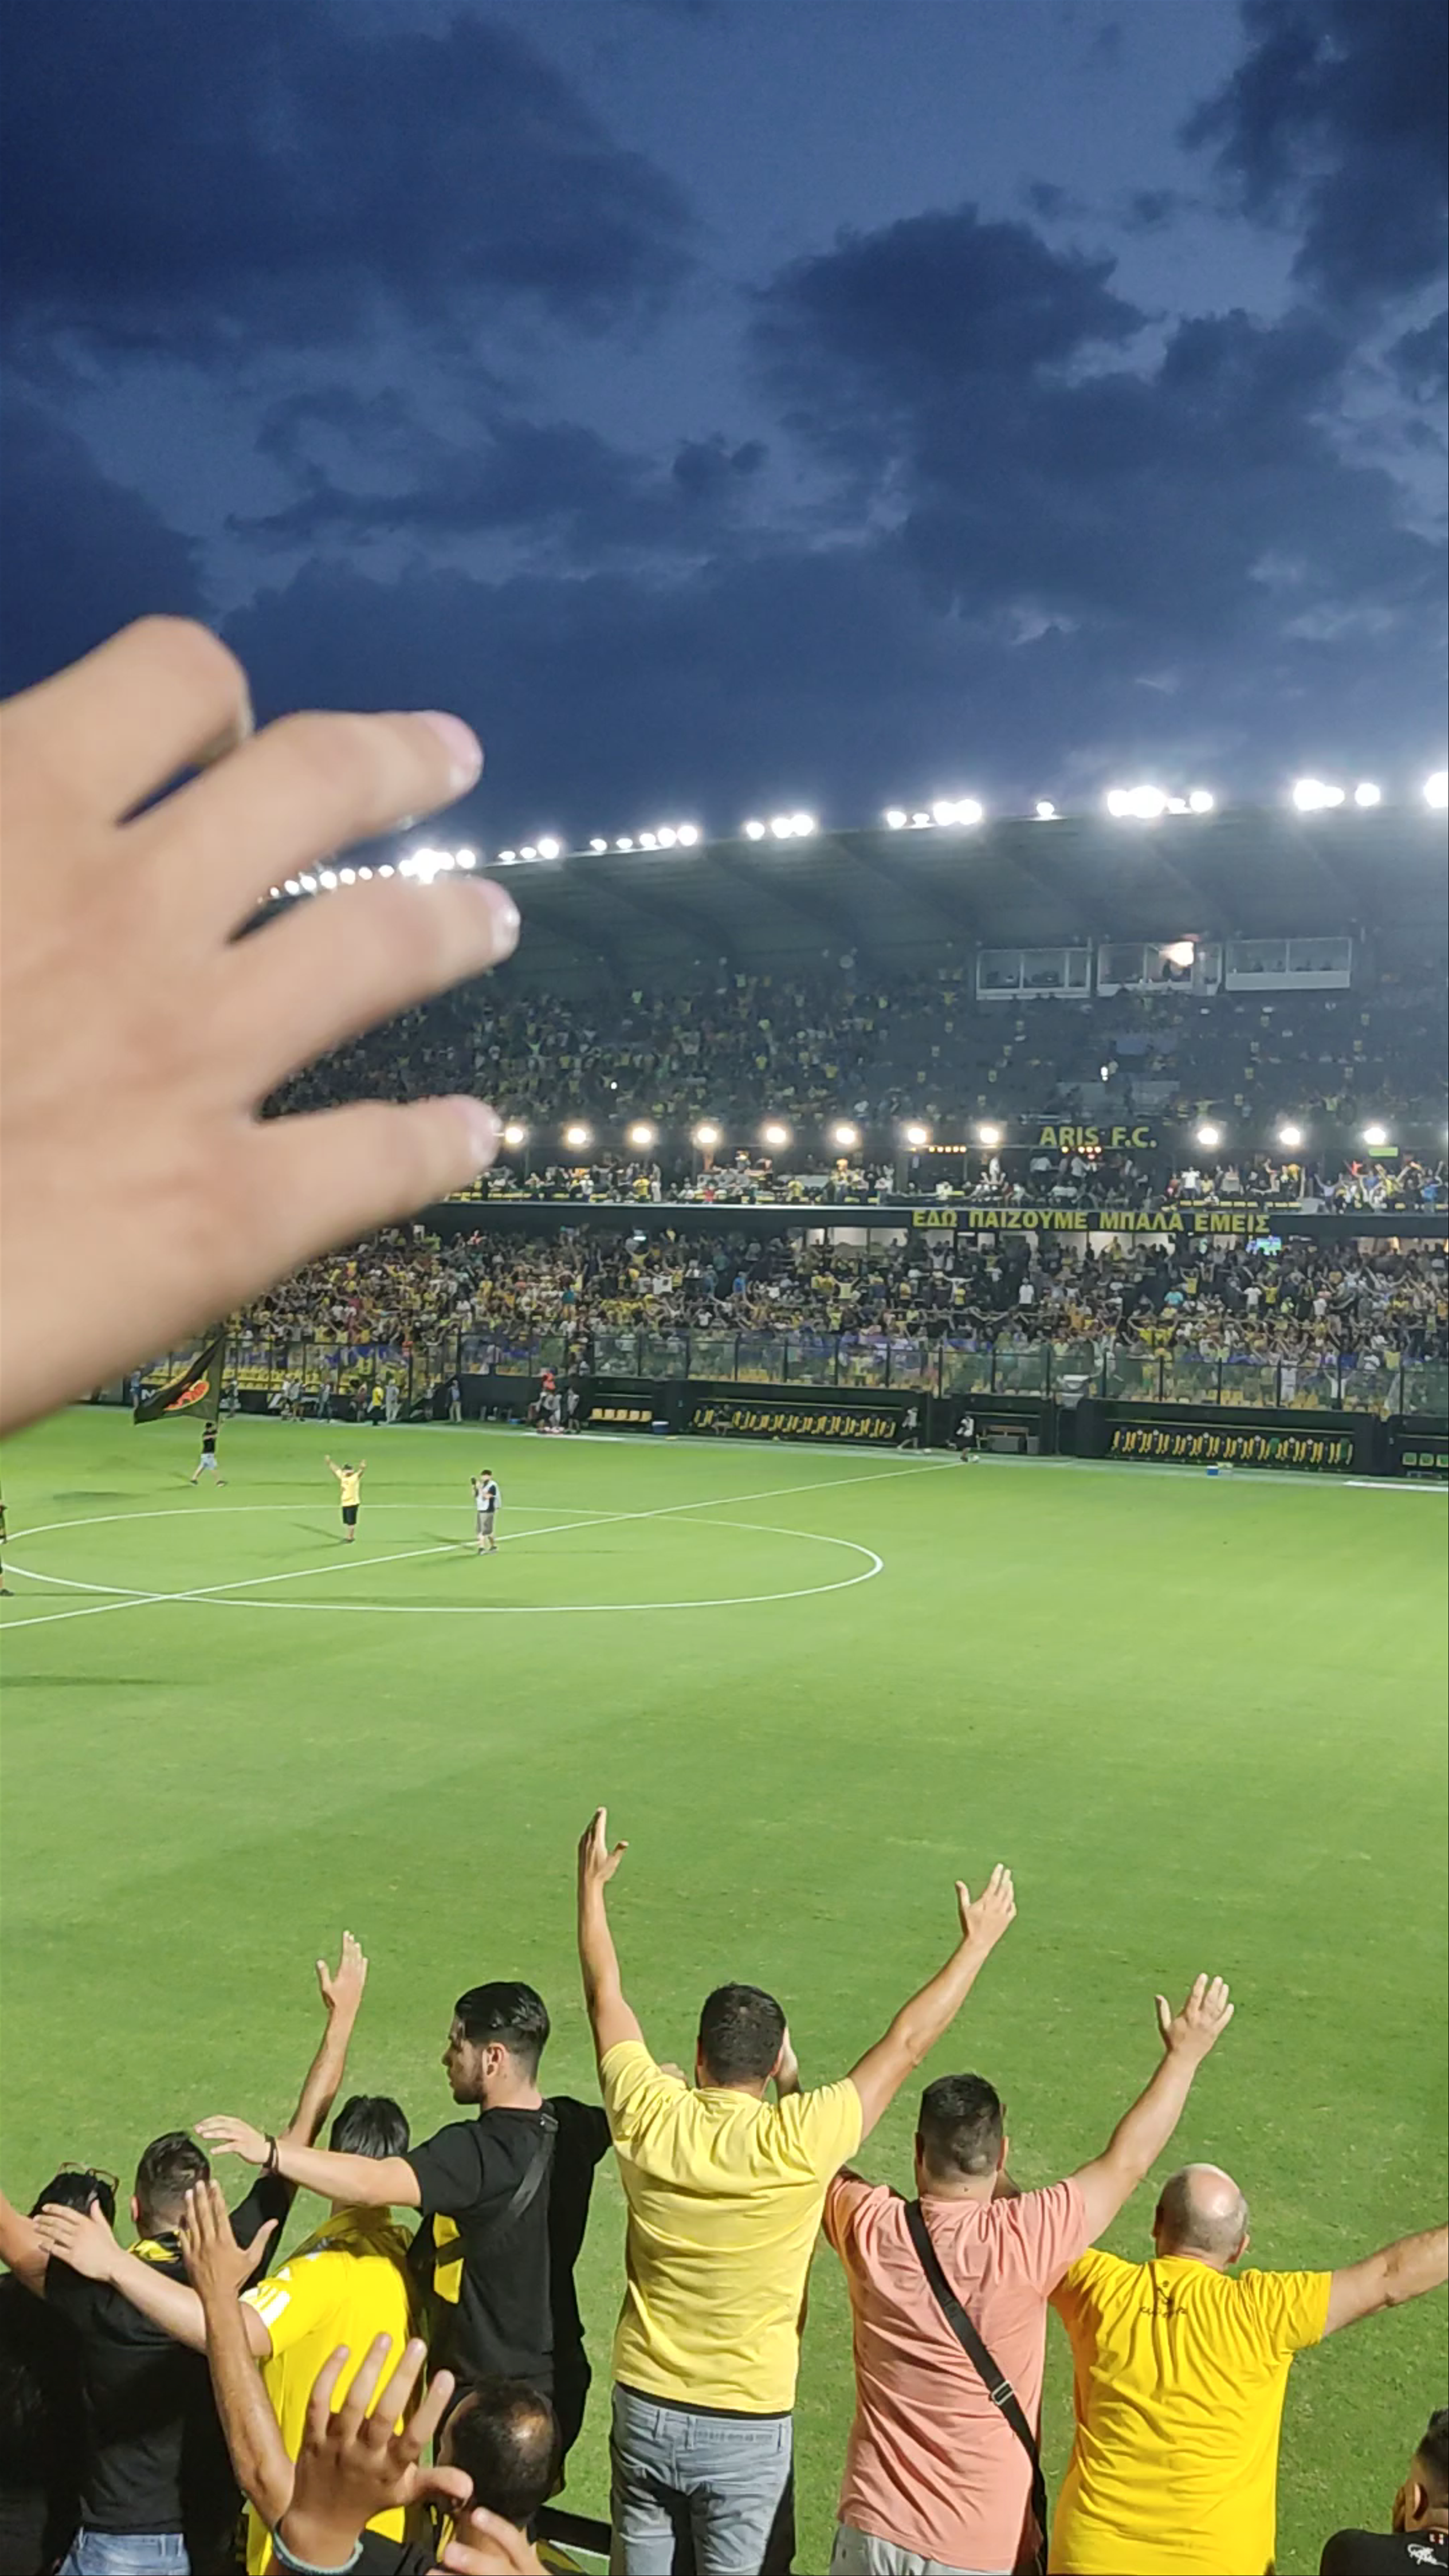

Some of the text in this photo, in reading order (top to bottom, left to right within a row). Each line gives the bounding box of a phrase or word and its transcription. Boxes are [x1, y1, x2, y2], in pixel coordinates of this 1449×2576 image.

[1040, 1126, 1157, 1148] ARIS F.C.
[912, 1210, 1270, 1233] ΕΔΩ ΠΑΙΖΟΥΜΕ ΜΠΑΛΑ ΕΜΕΙΣ
